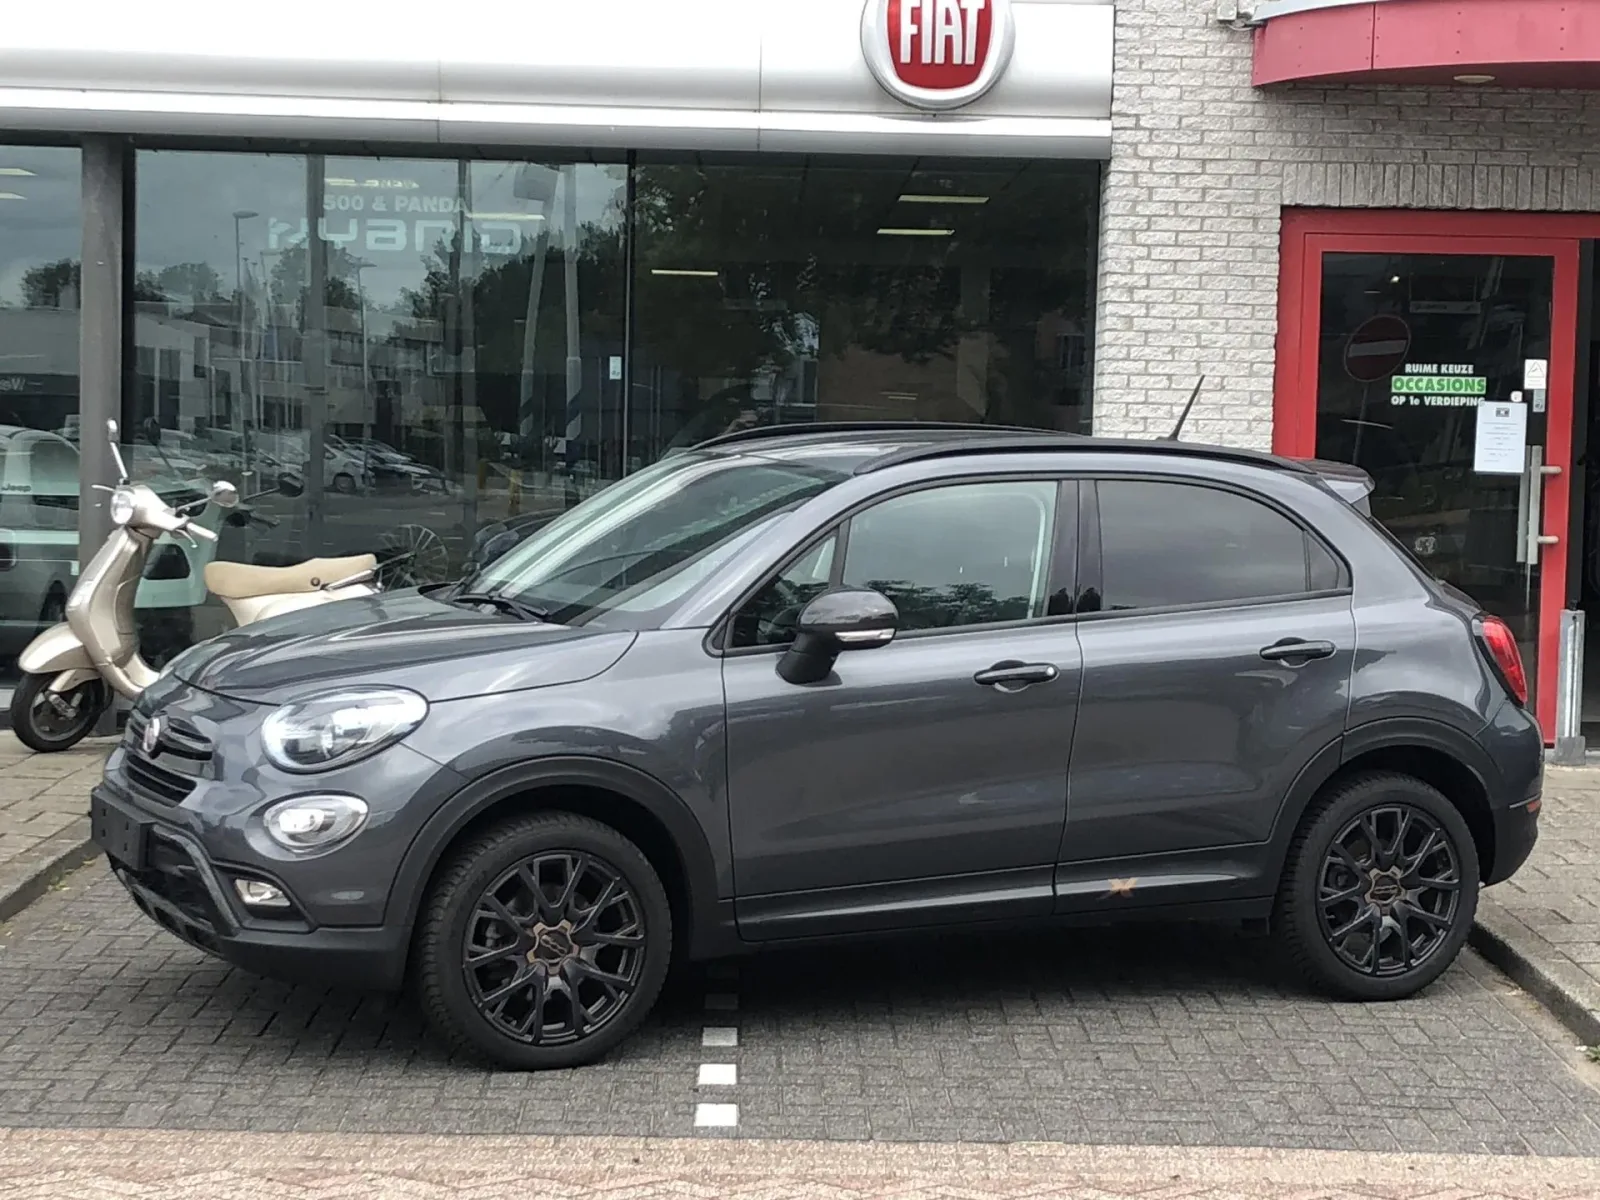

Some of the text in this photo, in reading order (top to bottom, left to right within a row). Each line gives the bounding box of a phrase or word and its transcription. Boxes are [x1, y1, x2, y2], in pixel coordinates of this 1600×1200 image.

[899, 0, 985, 65] FIAT
[323, 195, 468, 213] 500 & PANDA
[1405, 363, 1474, 374] RUIME KEUZE
[1393, 377, 1485, 393] OCCASIONS
[1391, 396, 1407, 405] OP
[1409, 396, 1420, 406] 1e
